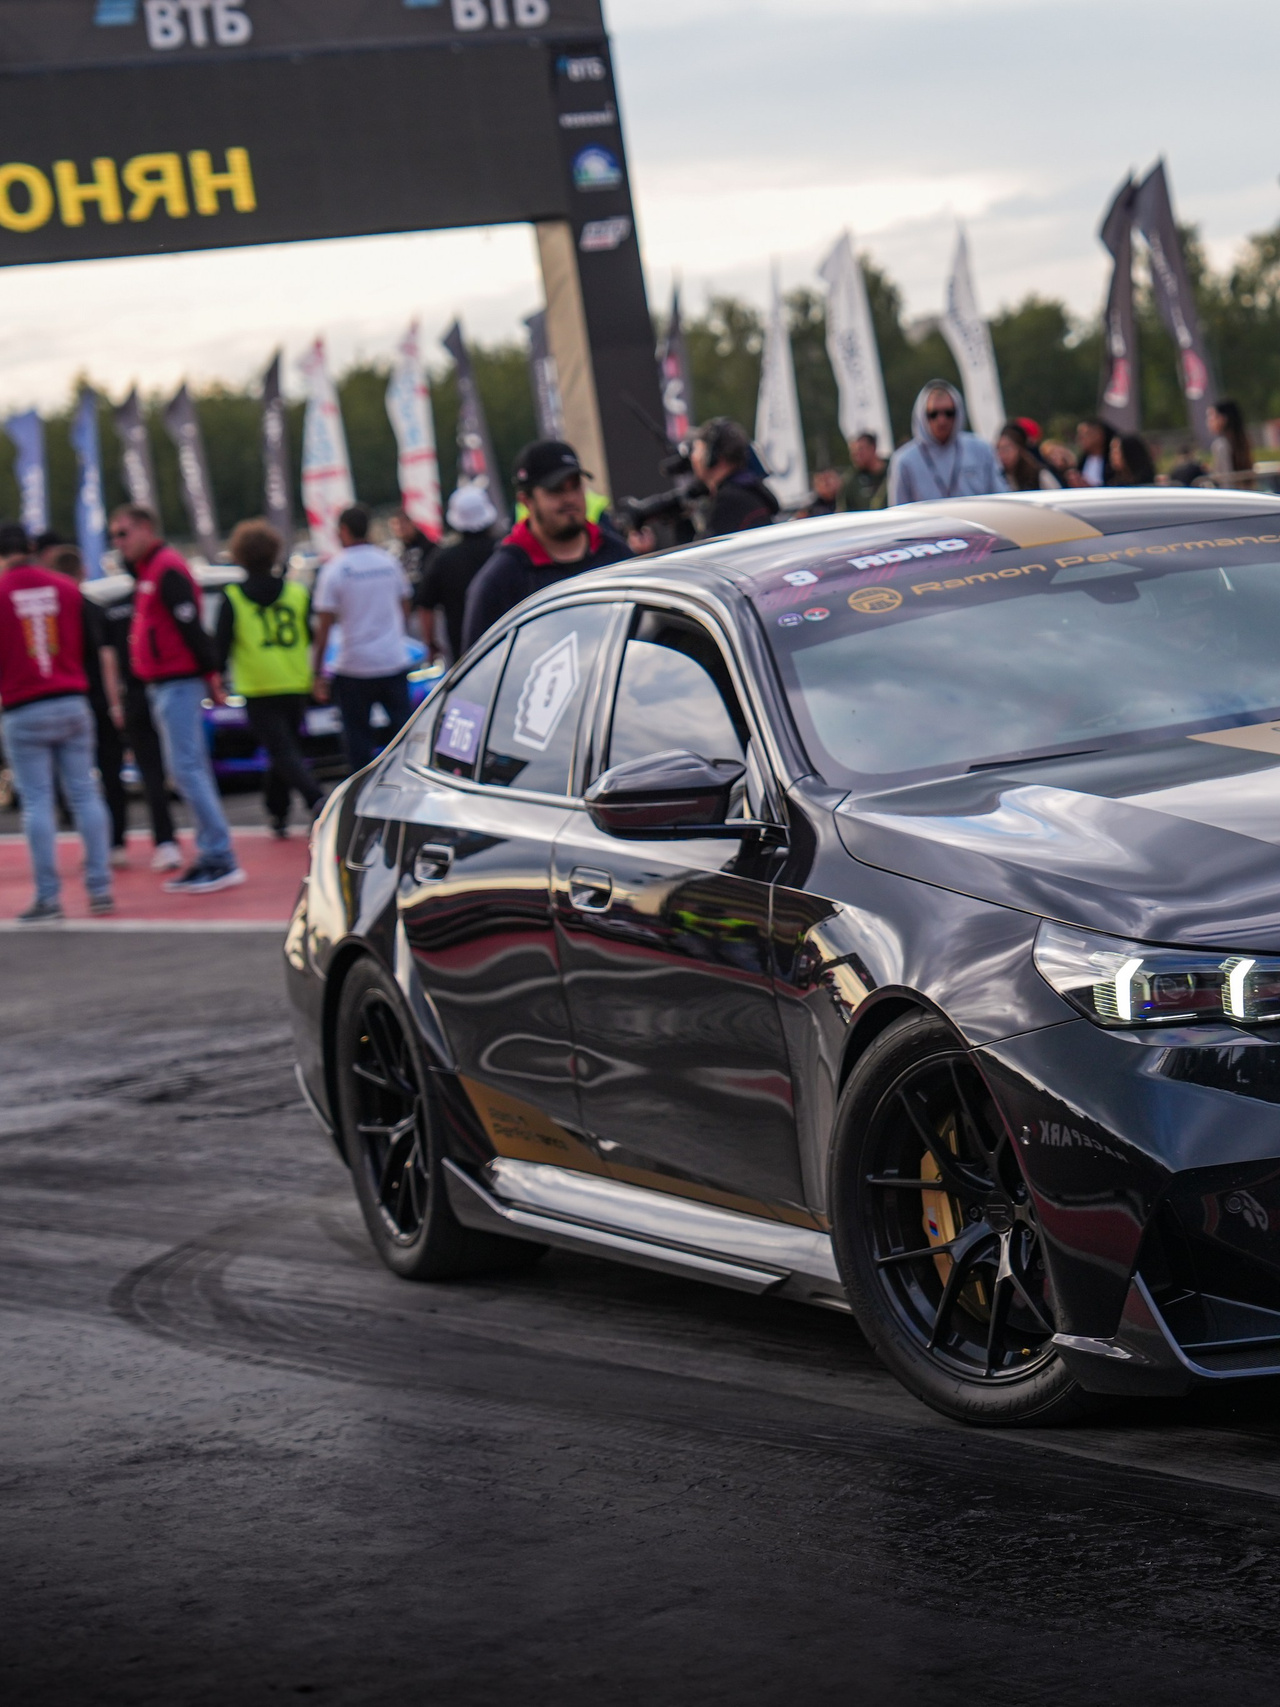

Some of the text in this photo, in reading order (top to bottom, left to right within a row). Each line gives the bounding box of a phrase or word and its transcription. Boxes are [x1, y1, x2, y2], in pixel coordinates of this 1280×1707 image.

[143, 0, 252, 50] ВТБ
[910, 563, 1047, 596] Ramon
[256, 605, 299, 648] 18
